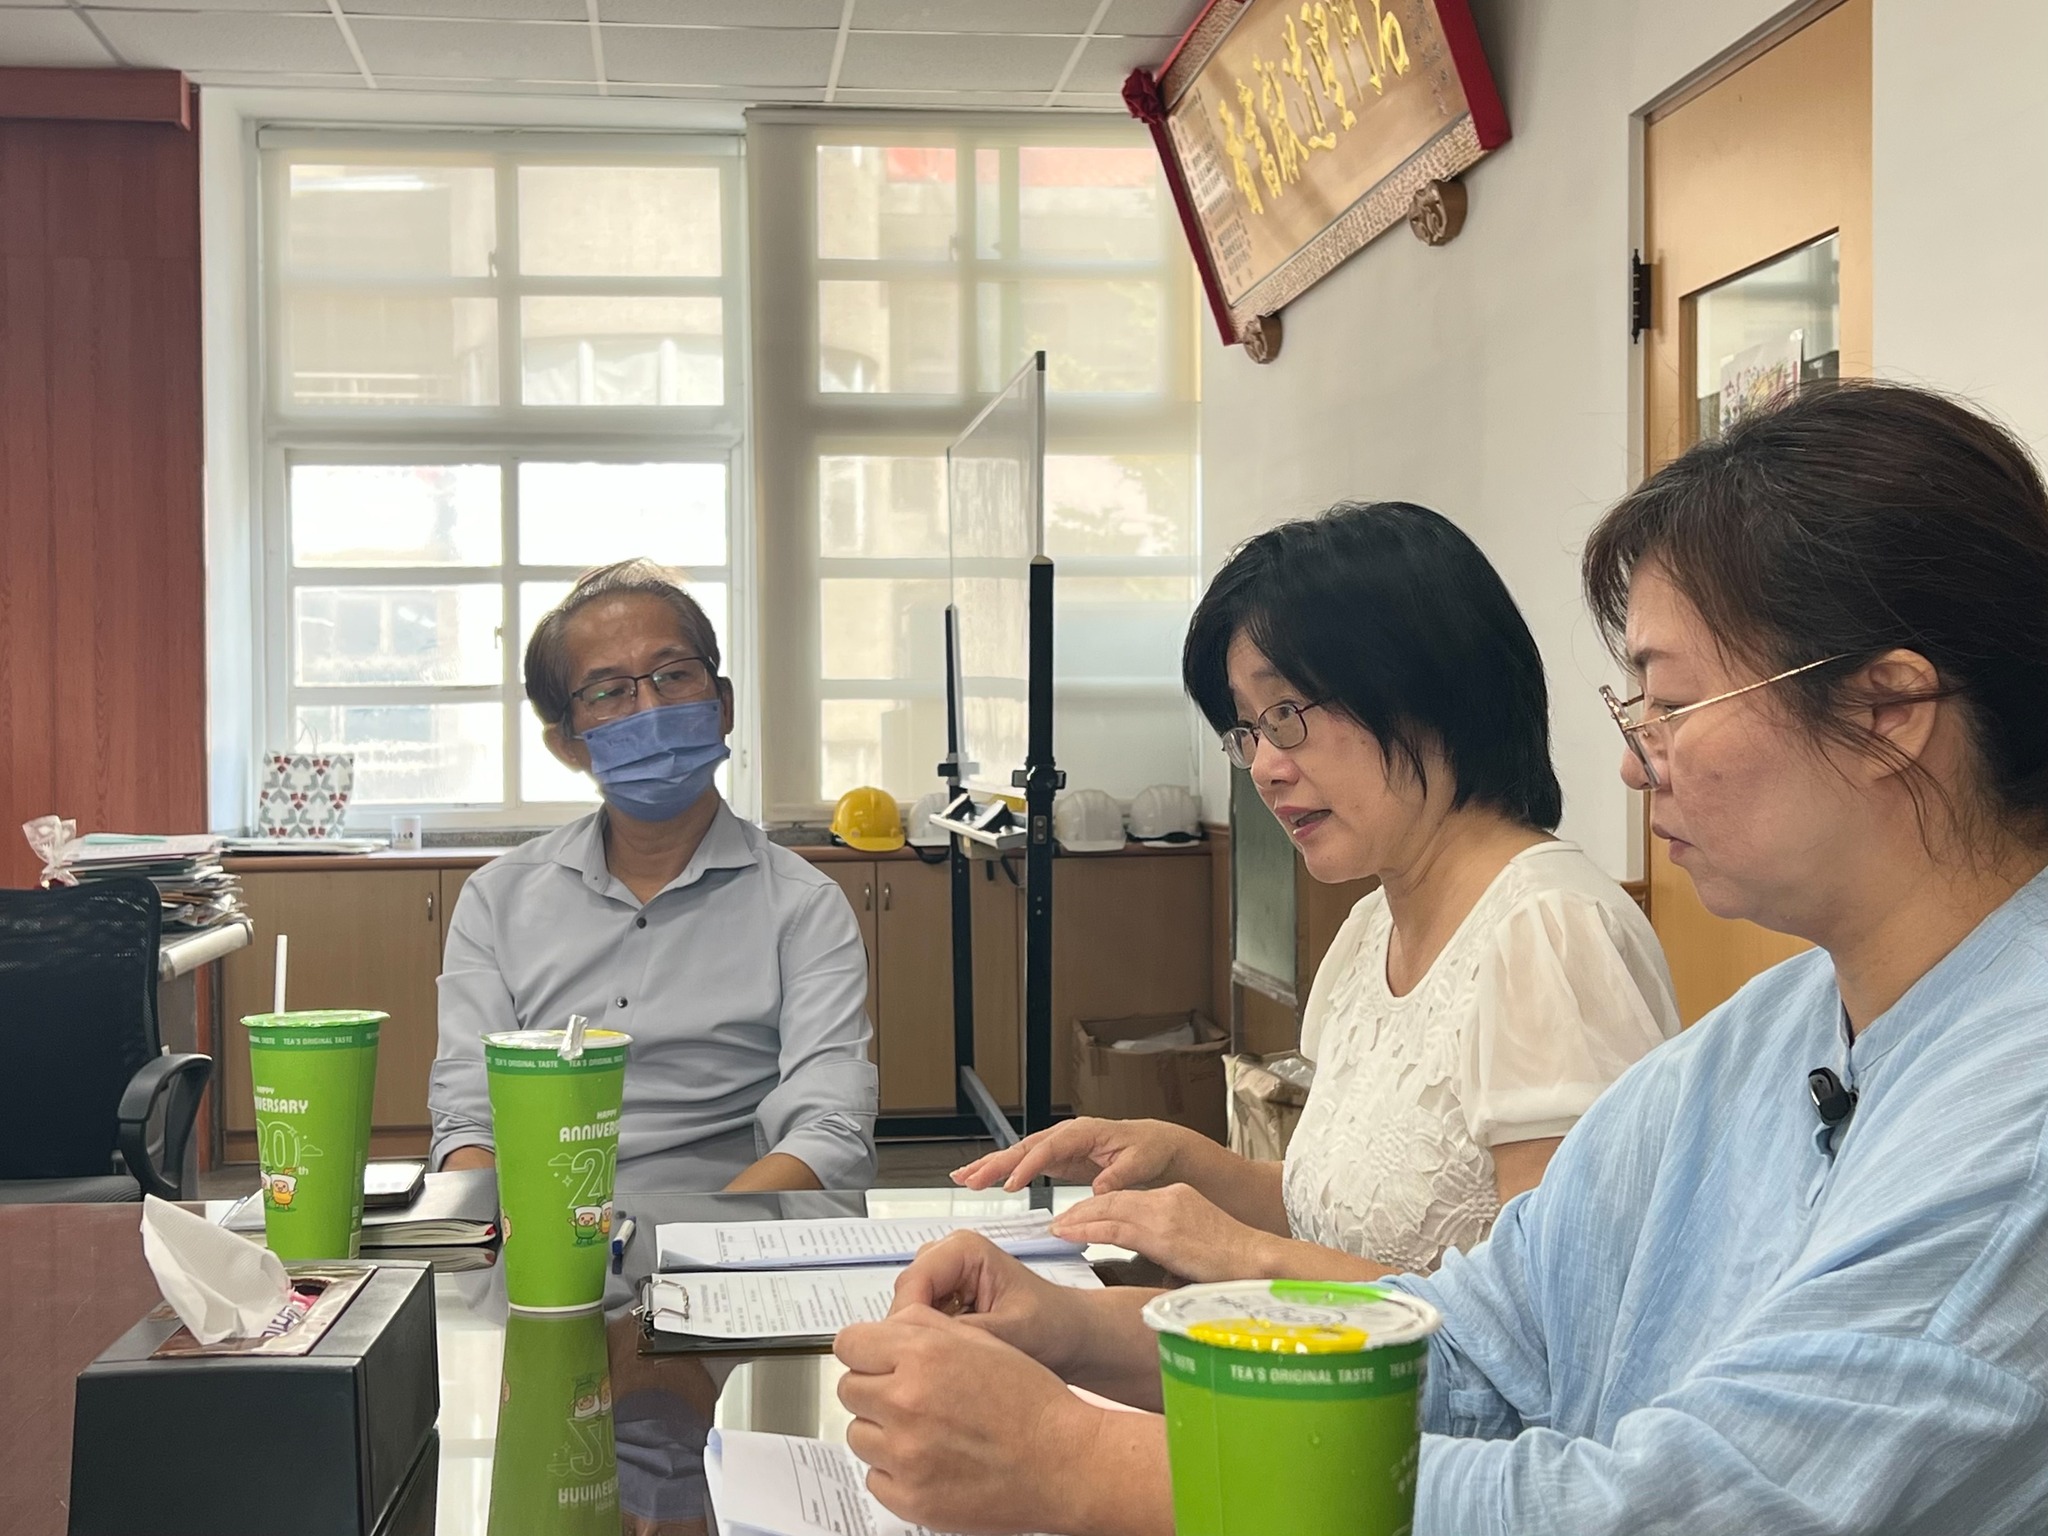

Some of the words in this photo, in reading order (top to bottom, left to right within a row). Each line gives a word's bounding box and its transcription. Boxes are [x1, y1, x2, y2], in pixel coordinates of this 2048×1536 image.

[283, 1037, 301, 1046] TEA'S
[302, 1036, 333, 1045] ORIGINAL
[335, 1035, 353, 1044] TASTE
[508, 1059, 537, 1068] ORIGINAL
[538, 1060, 559, 1068] TASTE
[569, 1058, 587, 1067] TEA'S
[596, 1108, 618, 1120] HAPPY
[298, 1166, 309, 1175] th
[1230, 1364, 1267, 1383] TEA'S
[1269, 1367, 1333, 1386] ORIGINAL
[1337, 1367, 1375, 1385] TASTE
